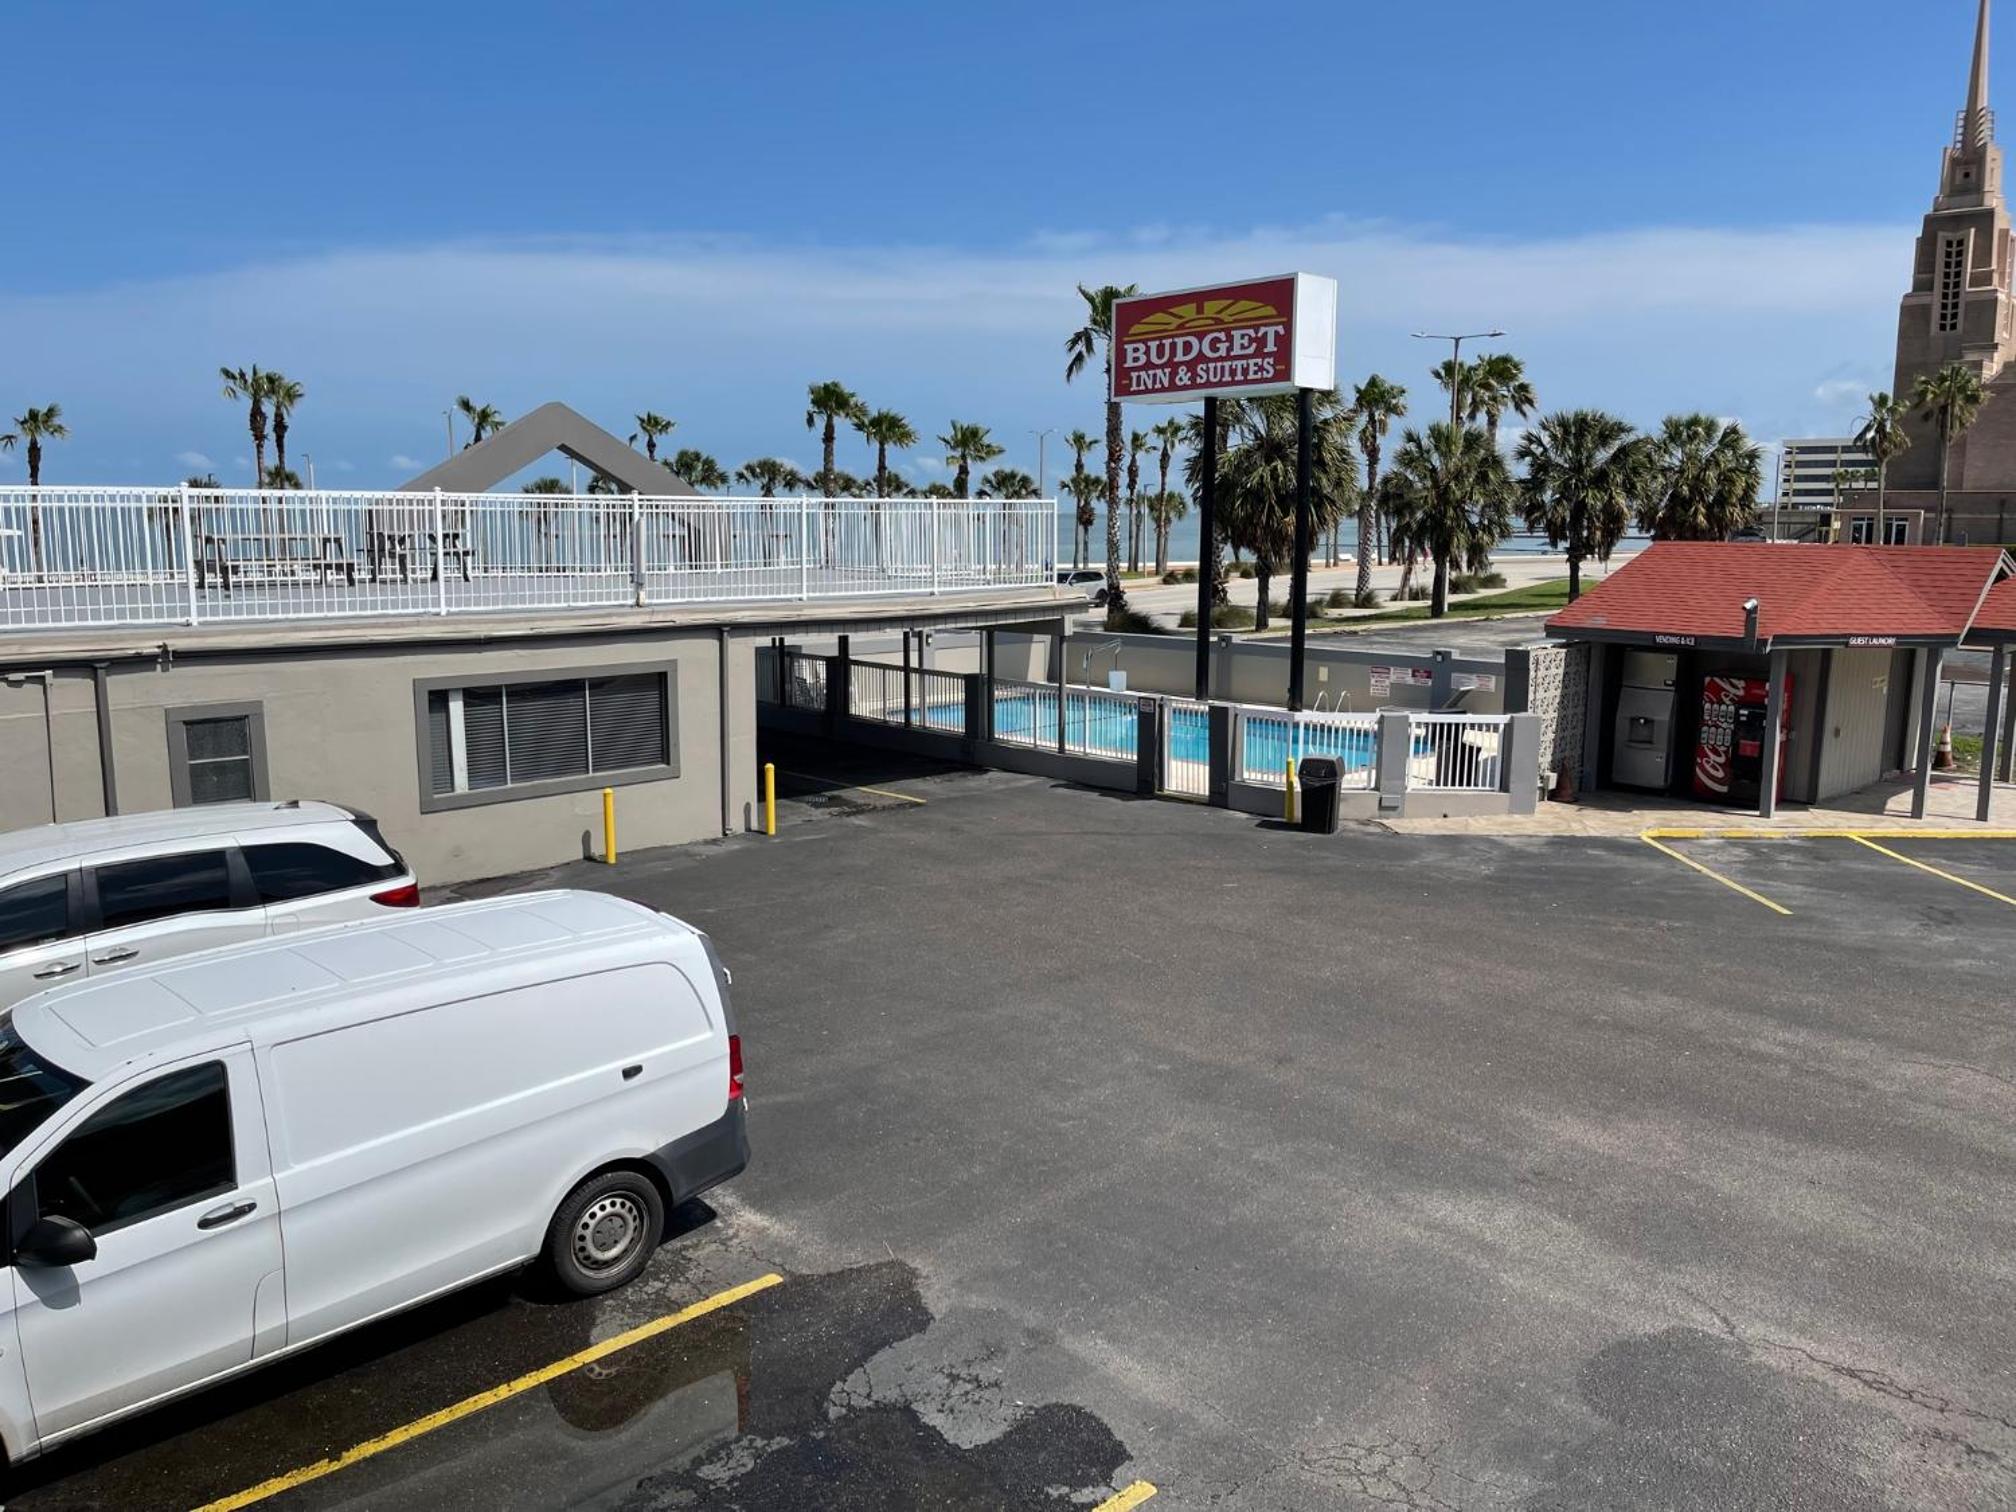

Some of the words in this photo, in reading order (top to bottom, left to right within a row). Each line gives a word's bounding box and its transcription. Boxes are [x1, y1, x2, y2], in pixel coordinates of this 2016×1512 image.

[1124, 325, 1285, 368] BUDGET
[1130, 368, 1171, 391] INN
[1175, 366, 1192, 386] &
[1196, 358, 1274, 384] SUITES
[1849, 636, 1868, 645] GUEST
[1869, 636, 1896, 646] LAUNDRY
